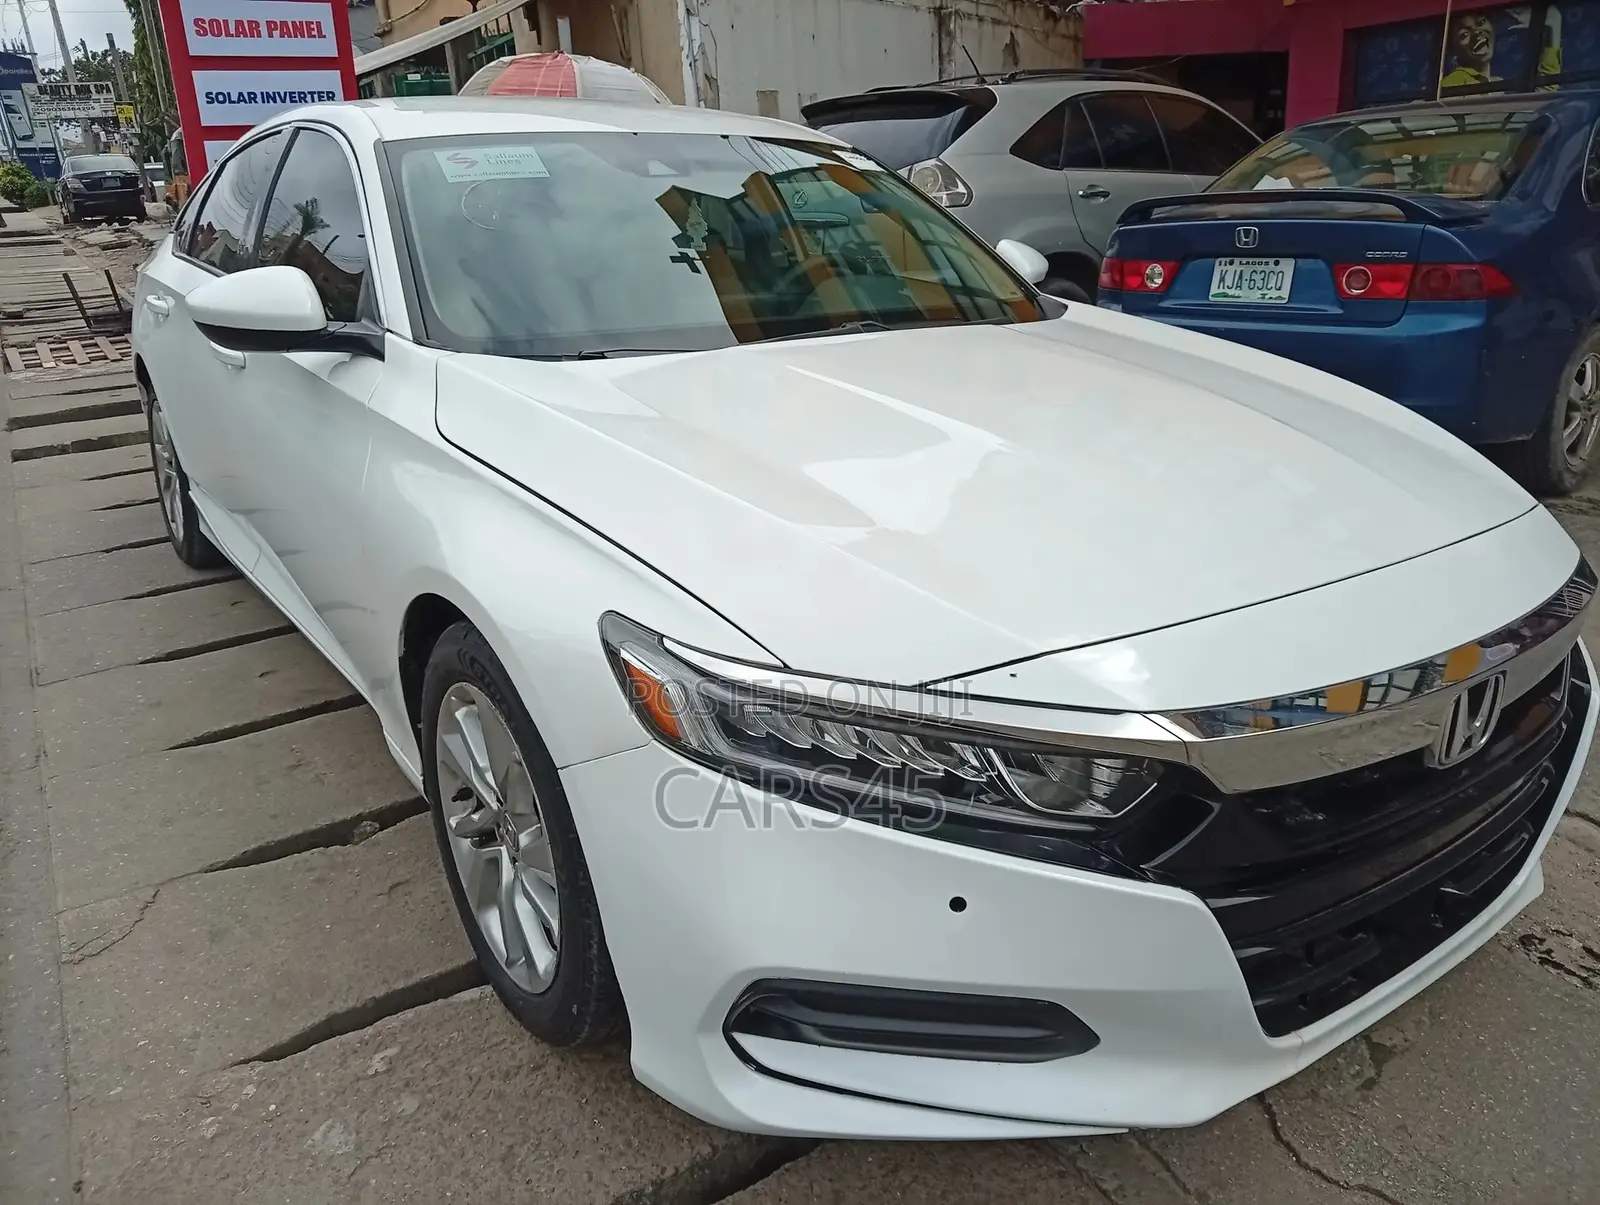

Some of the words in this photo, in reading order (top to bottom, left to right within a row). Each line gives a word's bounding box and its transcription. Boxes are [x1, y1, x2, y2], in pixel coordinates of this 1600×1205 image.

[193, 17, 262, 38] SOLAR
[266, 20, 327, 39] PANEL
[37, 84, 72, 96] BEAUTY
[94, 83, 112, 94] SPA
[205, 91, 258, 105] SOLAR
[261, 91, 336, 104] INVERTER
